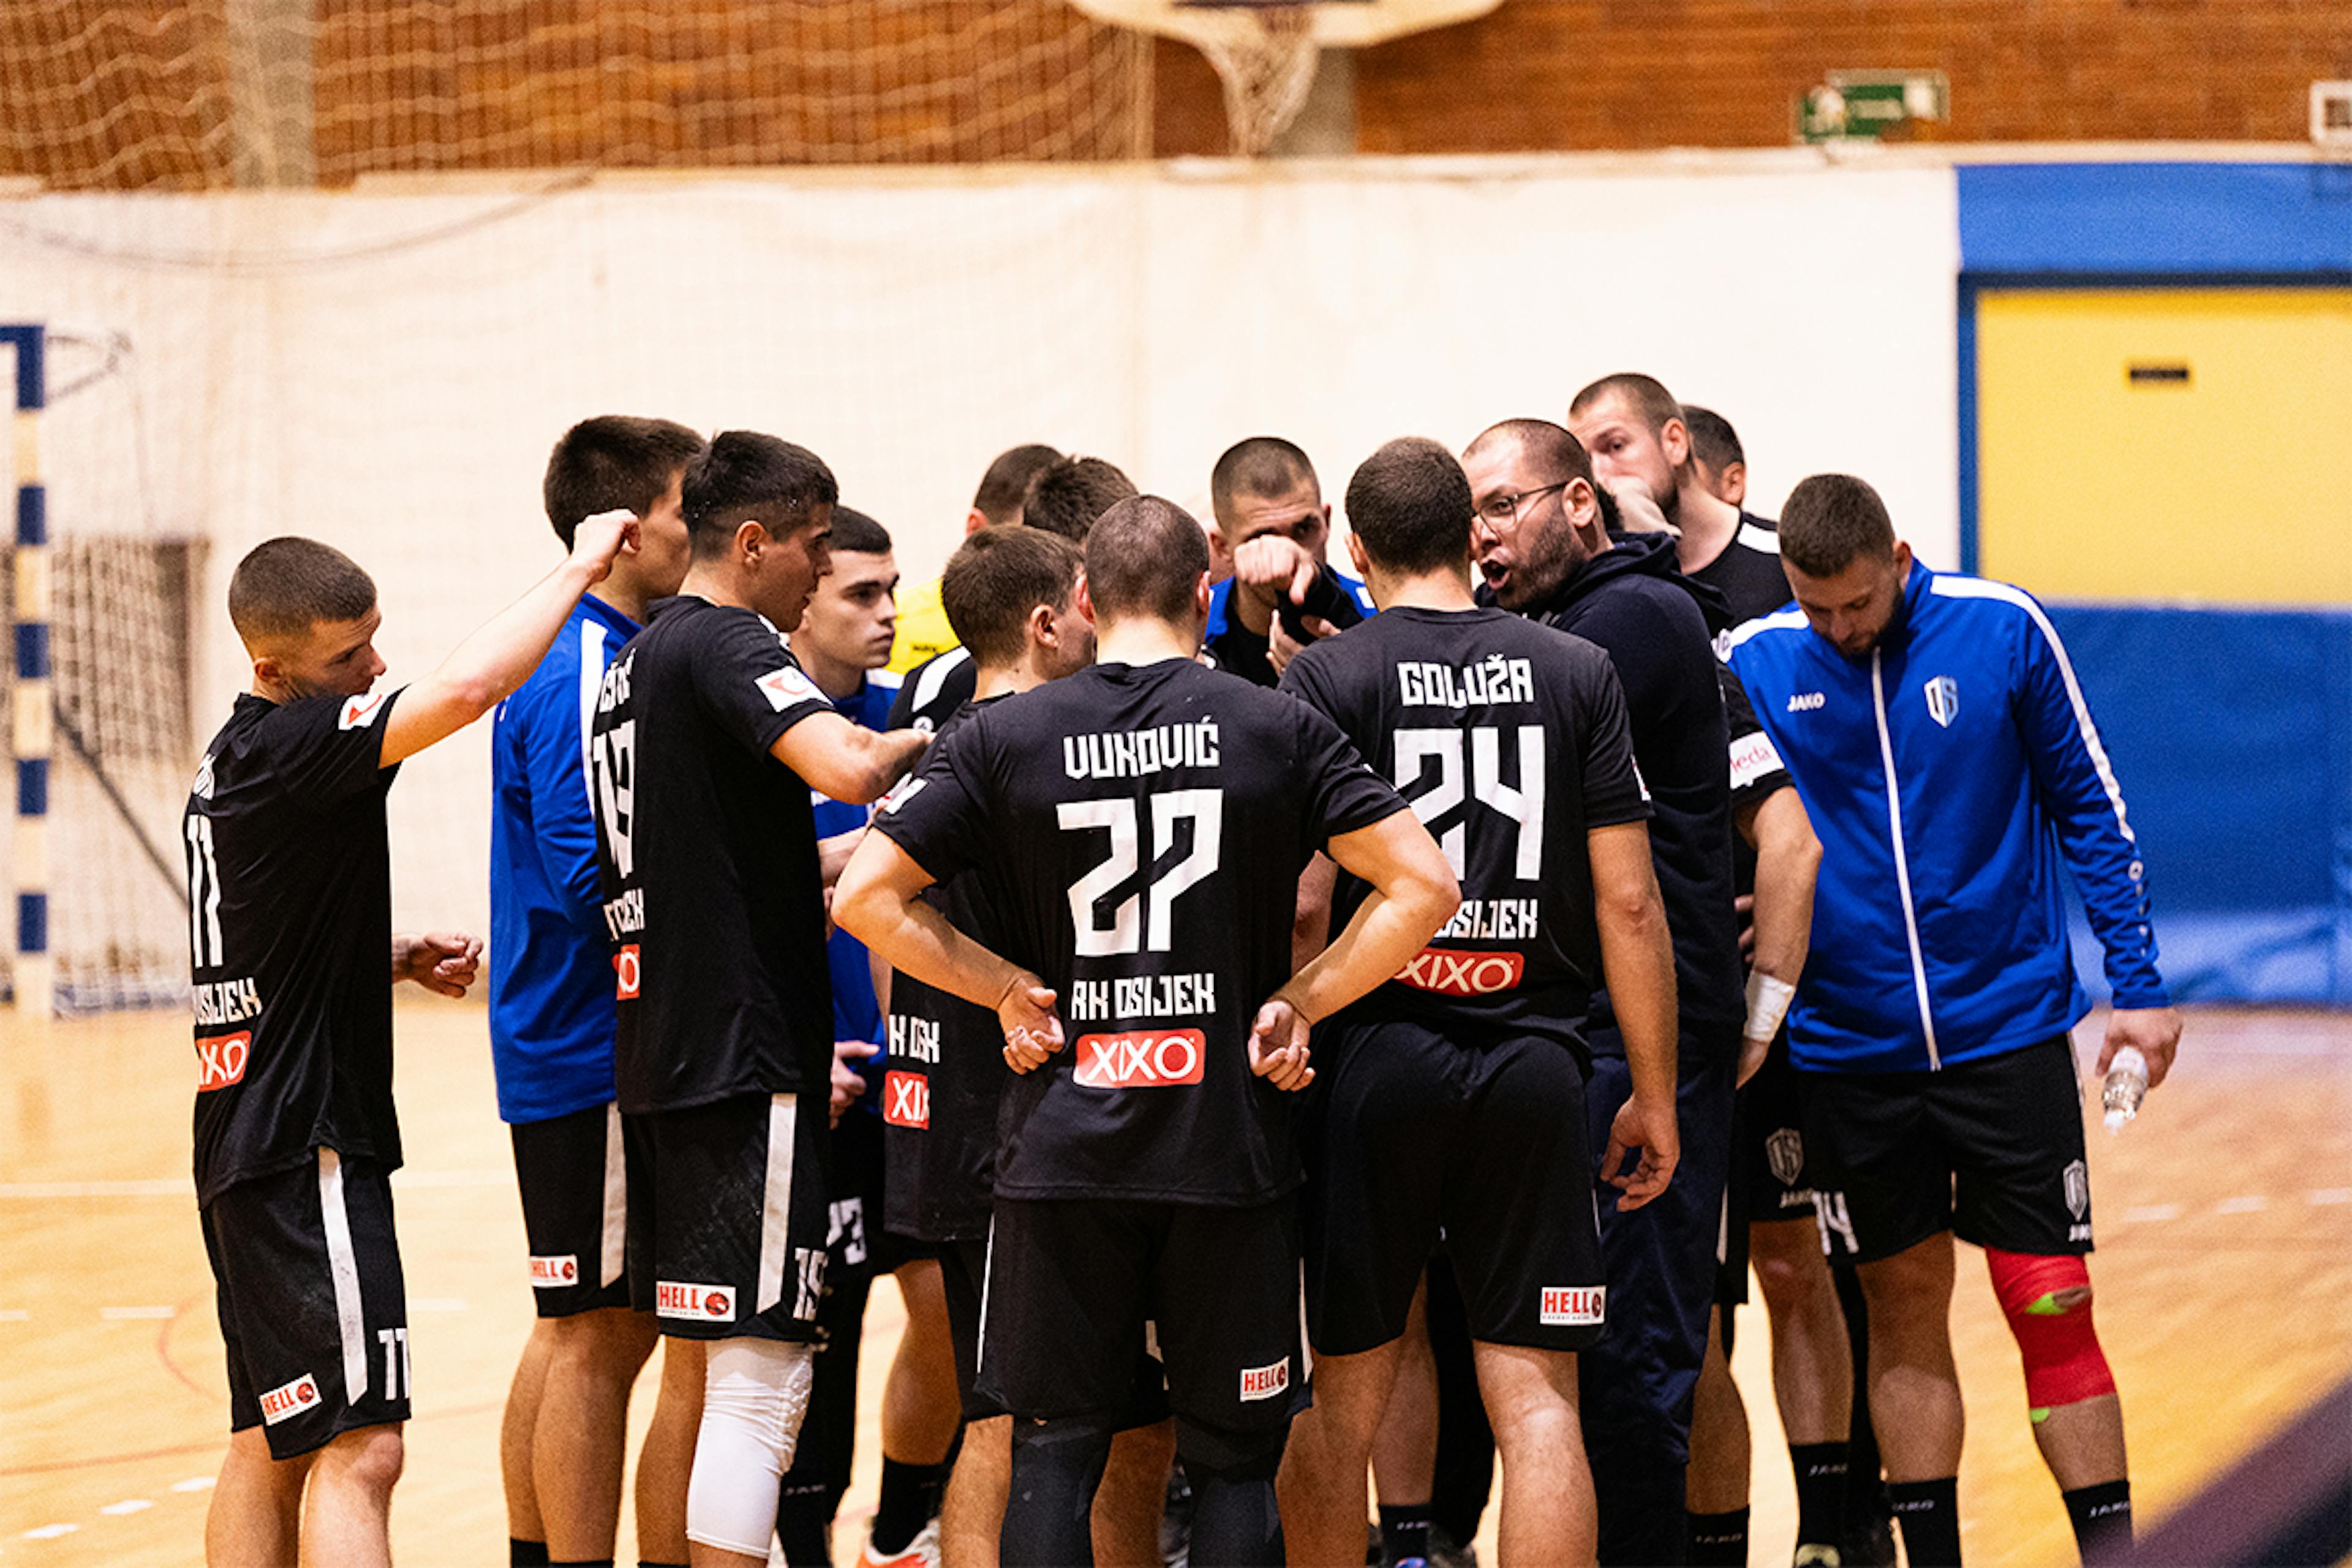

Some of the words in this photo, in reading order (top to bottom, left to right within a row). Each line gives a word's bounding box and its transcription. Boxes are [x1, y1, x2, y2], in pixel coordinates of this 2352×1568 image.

[1396, 653, 1534, 709] GOLUŽA
[1787, 691, 1825, 712] JAKO
[1063, 715, 1219, 780] VUKOVIĆ
[1394, 725, 1545, 881] 24
[187, 814, 223, 968] 11
[1056, 789, 1223, 956] 27
[1071, 981, 1109, 1020] RK
[1114, 973, 1216, 1019] OSIJEK
[1394, 953, 1515, 993] XIXO
[1087, 1035, 1196, 1080] XIXO
[1812, 1191, 1860, 1256] 14
[658, 1285, 699, 1310] HELL
[1544, 1291, 1589, 1313] HELL
[377, 1328, 410, 1401] 11
